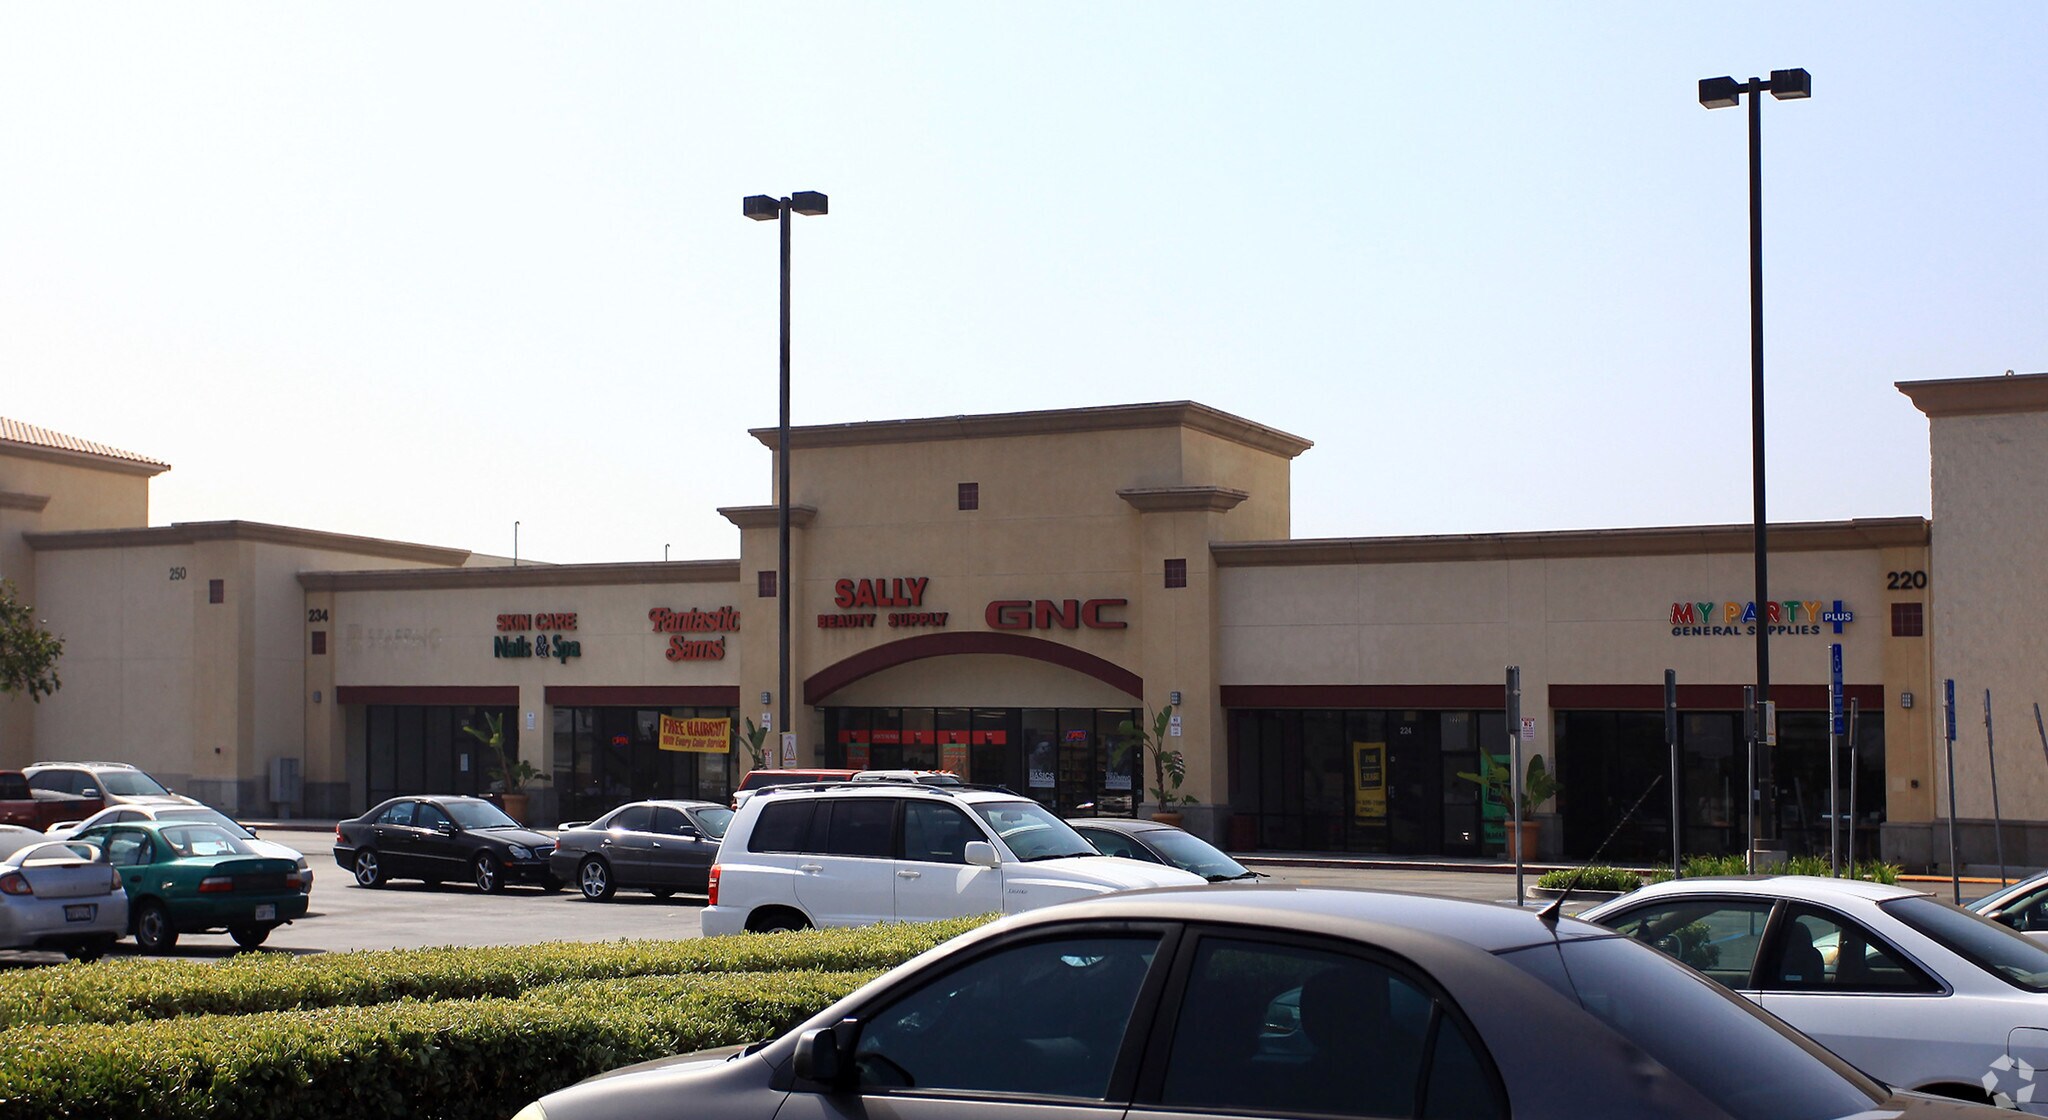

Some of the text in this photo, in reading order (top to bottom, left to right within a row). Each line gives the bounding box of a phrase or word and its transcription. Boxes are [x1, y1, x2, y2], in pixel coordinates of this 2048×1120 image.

[169, 566, 187, 581] 250
[1887, 571, 1928, 590] 220
[834, 577, 929, 609] SALLY
[308, 609, 329, 623] 234
[496, 613, 578, 632] SKIN CARE
[648, 606, 741, 633] Fantastic
[817, 612, 949, 629] BEAUTY SUPPLY
[985, 599, 1128, 629] GNC
[1670, 602, 1714, 624] MY
[1825, 613, 1852, 622] PLUS
[1671, 625, 1821, 637] GENERAL SPPLIES
[494, 634, 582, 665] Nails & Spa
[663, 718, 728, 737] FREE HAIRCUT
[1400, 727, 1412, 735] 224
[676, 737, 692, 749] Every
[706, 739, 727, 749] Service
